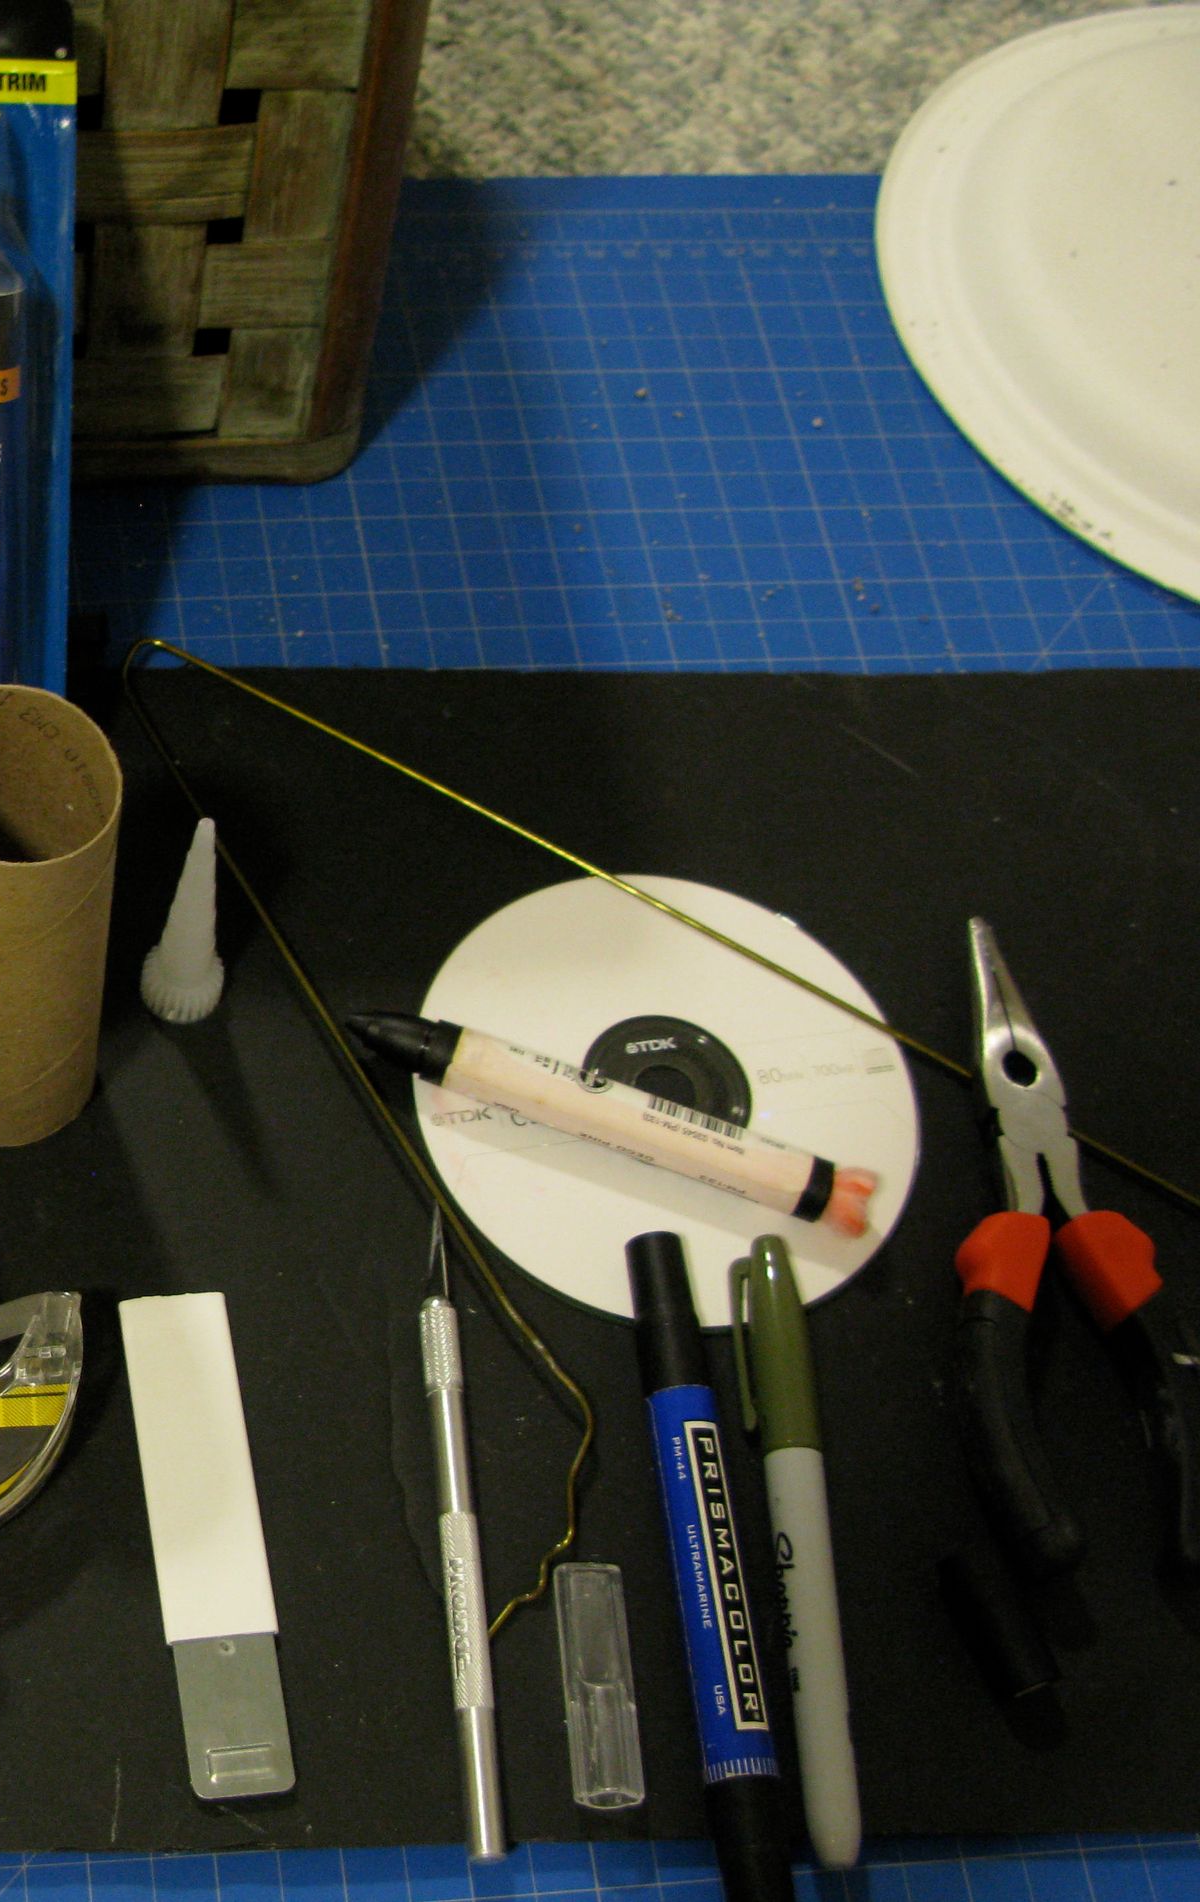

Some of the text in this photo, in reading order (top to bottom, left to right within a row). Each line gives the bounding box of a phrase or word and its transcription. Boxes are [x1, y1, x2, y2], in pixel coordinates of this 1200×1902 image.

[444, 1106, 492, 1125] TDK
[639, 1037, 677, 1052] TDK
[672, 1436, 727, 1717] PM-44 ULTRAMARINE USA
[697, 1435, 761, 1720] PRISMACOLOR
